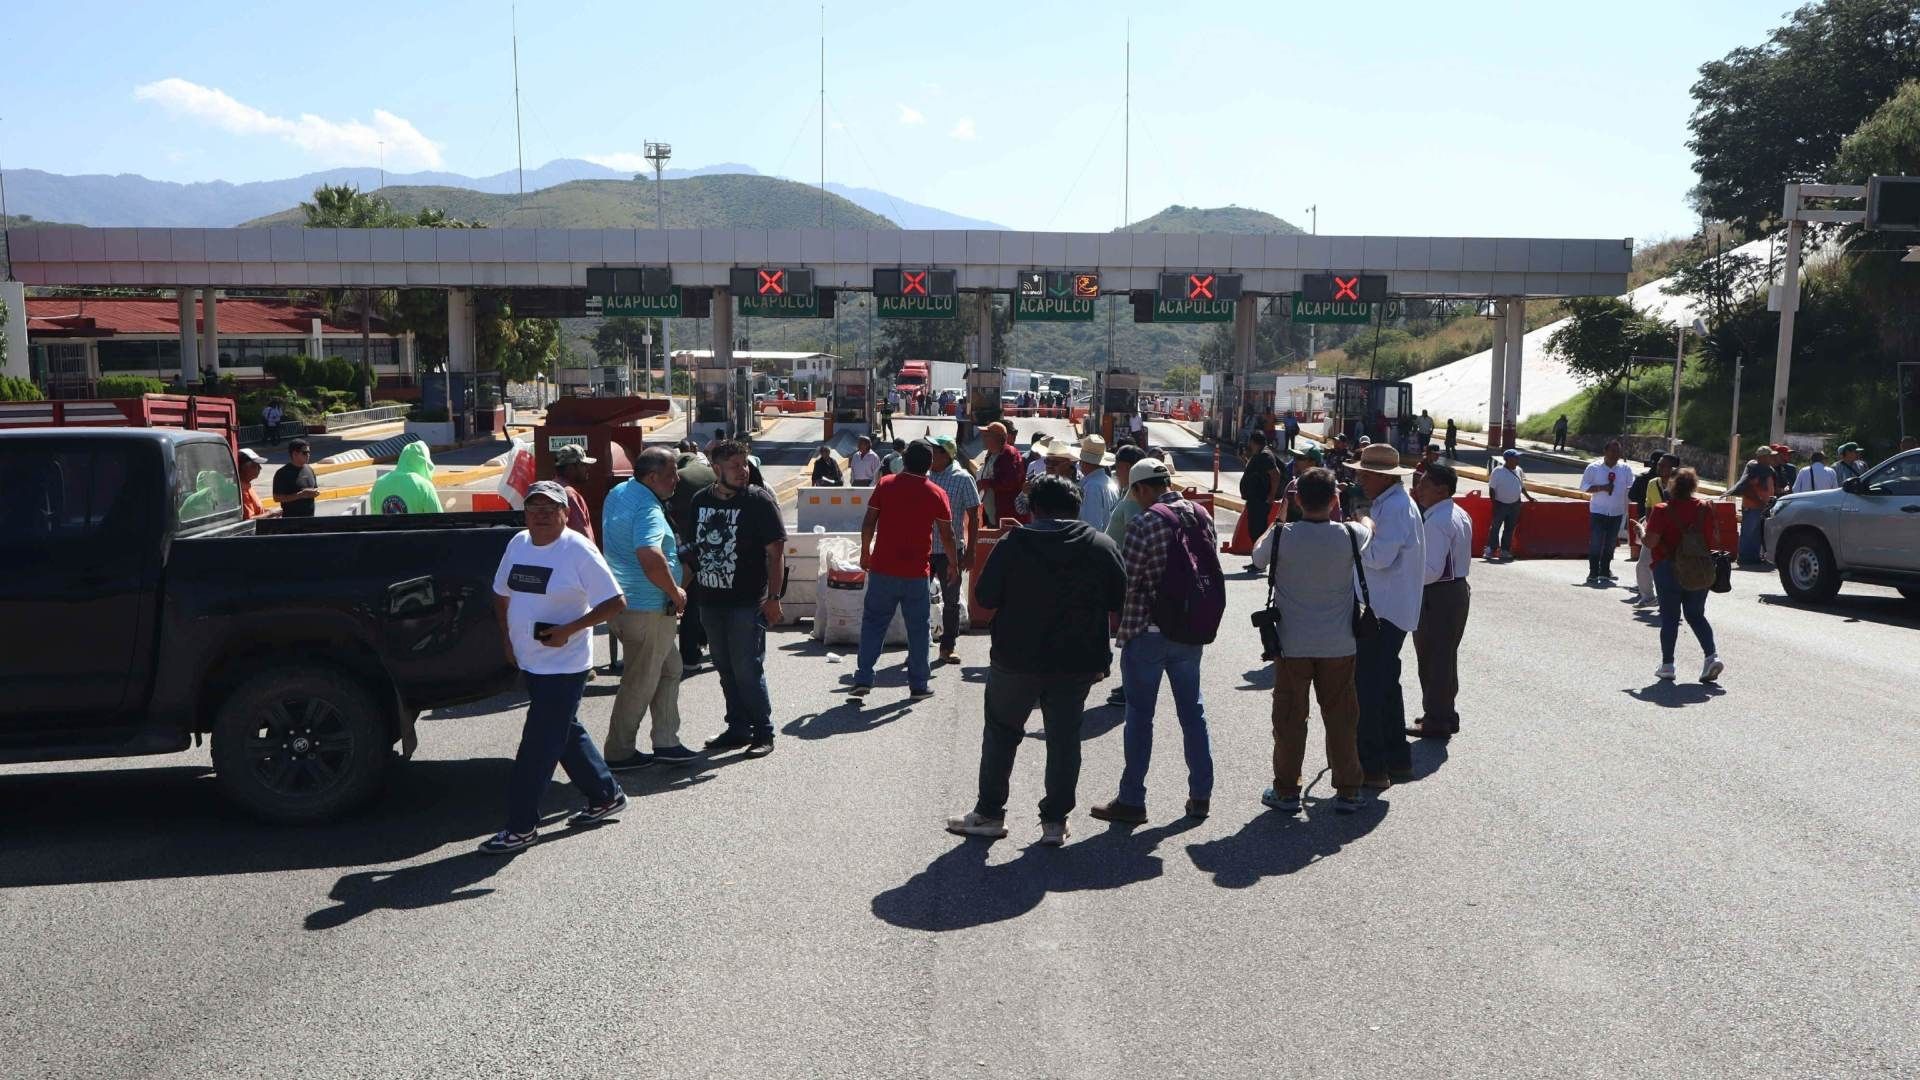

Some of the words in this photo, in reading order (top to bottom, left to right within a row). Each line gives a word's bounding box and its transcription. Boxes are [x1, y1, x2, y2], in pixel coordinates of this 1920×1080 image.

[606, 295, 678, 309] ACAPULCO
[743, 295, 814, 309] ACAPULCO
[883, 296, 952, 311] ACAPULCO
[1020, 298, 1090, 313] ACAPULCO
[1158, 299, 1230, 314] ACAPULCO
[1296, 301, 1367, 316] ACAPULCO
